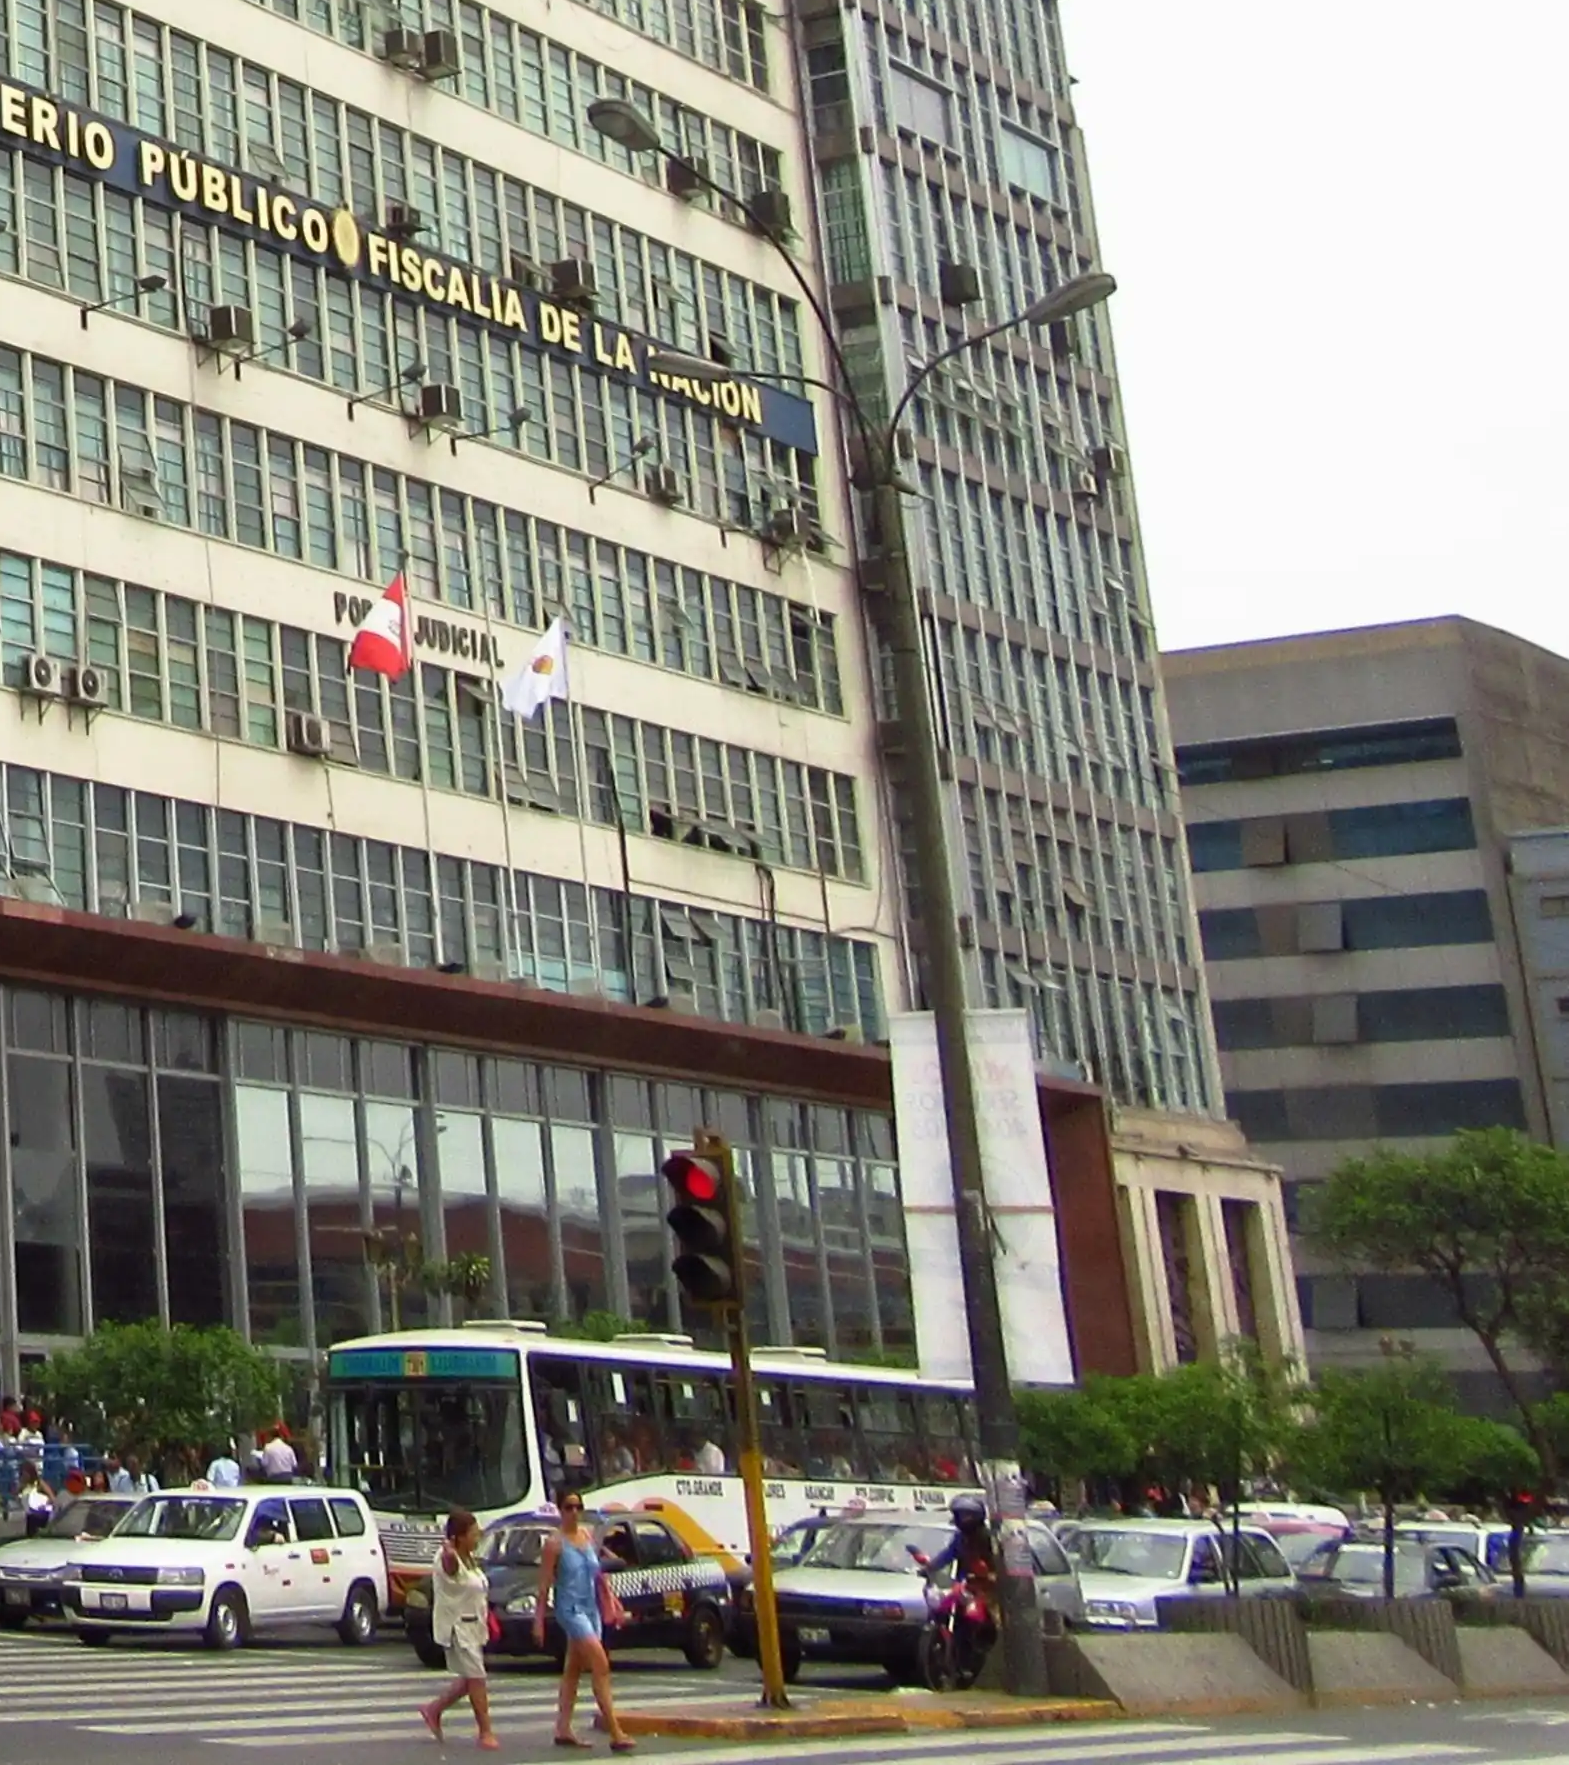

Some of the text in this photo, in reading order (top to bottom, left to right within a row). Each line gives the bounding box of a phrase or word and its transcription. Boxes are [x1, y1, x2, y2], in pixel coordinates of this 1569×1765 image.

[139, 140, 330, 254] PÚBLICO
[539, 300, 583, 354] DE
[593, 321, 638, 375] LA
[414, 614, 505, 668] JUDICIAL
